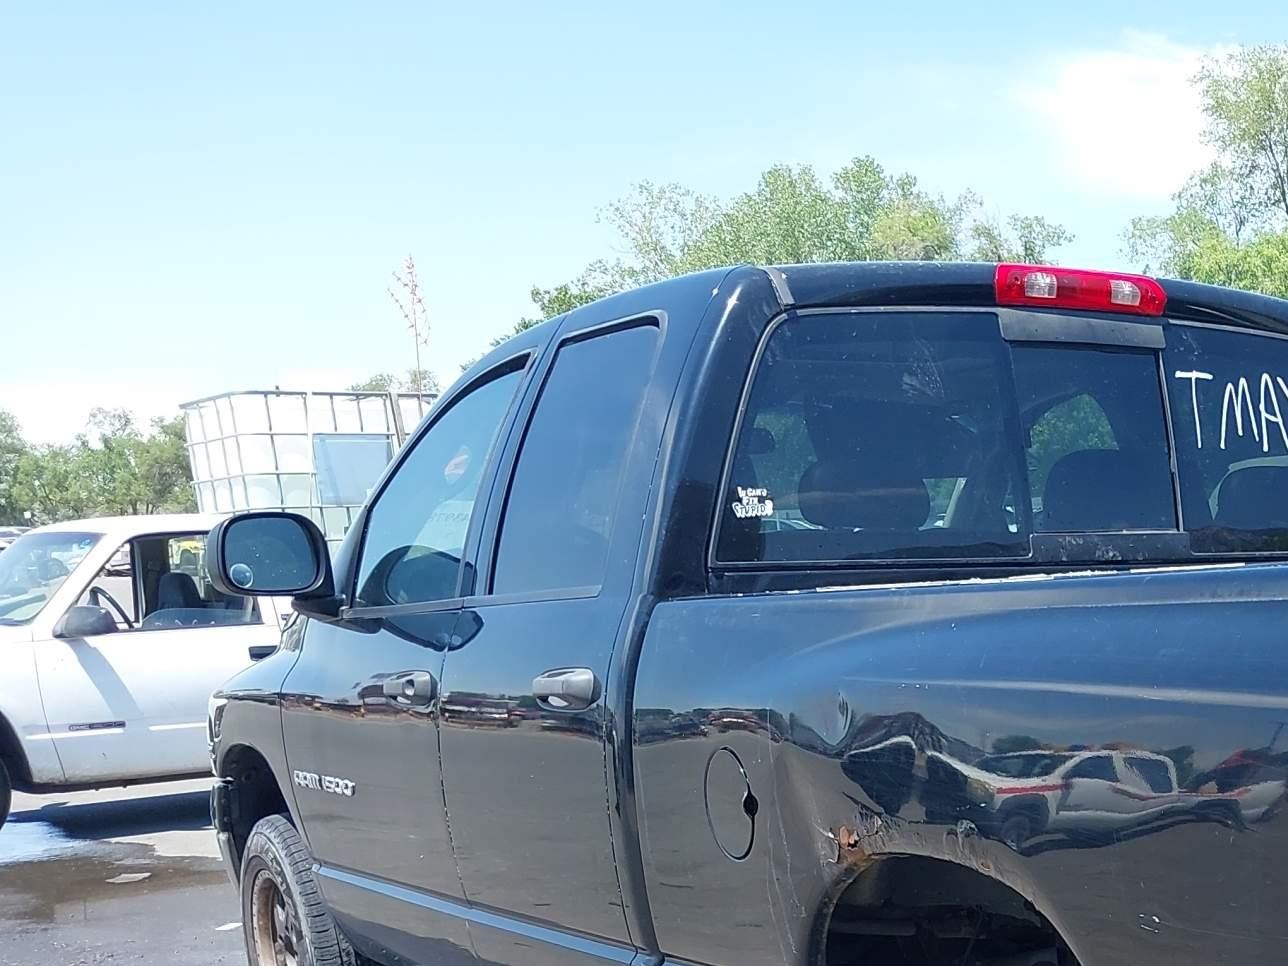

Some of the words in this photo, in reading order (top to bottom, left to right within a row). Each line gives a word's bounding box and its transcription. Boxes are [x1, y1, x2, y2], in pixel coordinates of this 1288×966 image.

[1175, 370, 1213, 448] T
[294, 770, 321, 790] RAM
[322, 775, 356, 797] 1500
